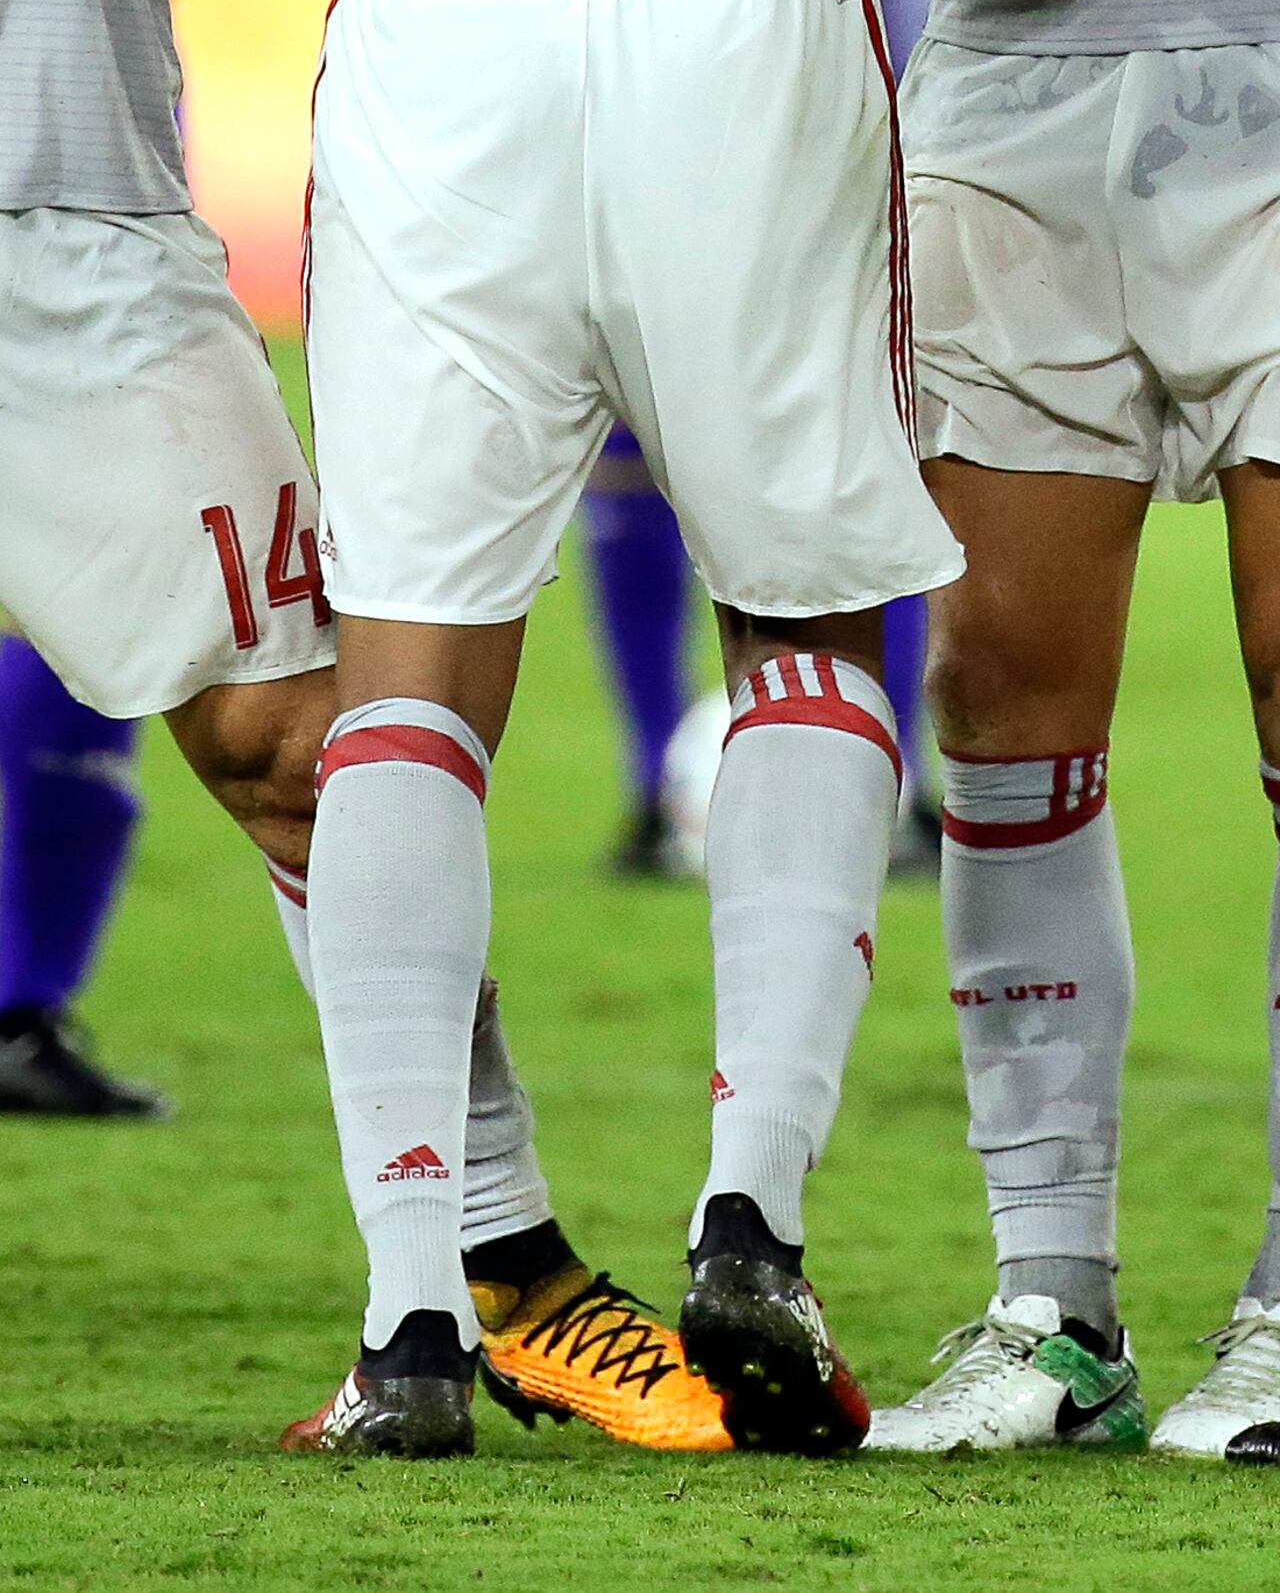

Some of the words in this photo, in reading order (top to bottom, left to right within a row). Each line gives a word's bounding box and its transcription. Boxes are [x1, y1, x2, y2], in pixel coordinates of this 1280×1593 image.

[201, 481, 332, 651] 14
[1004, 981, 1078, 1001] UTD
[377, 1166, 450, 1182] adidas
